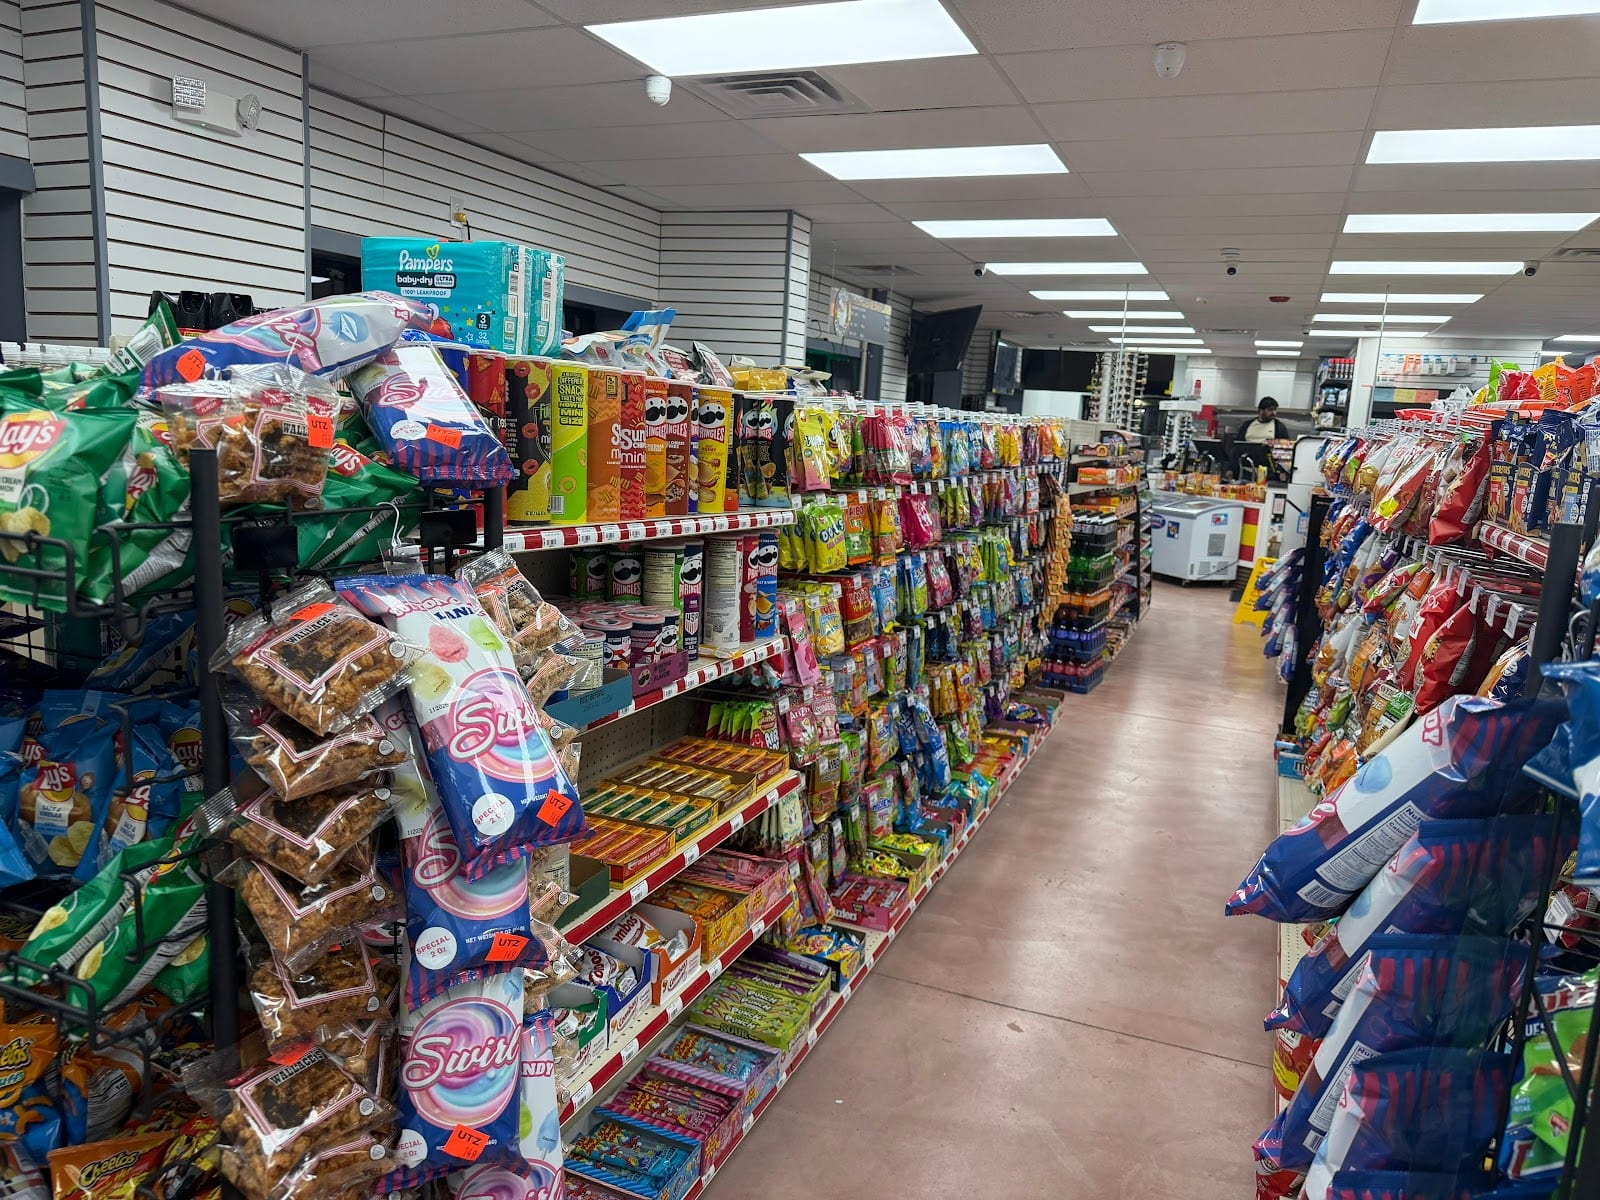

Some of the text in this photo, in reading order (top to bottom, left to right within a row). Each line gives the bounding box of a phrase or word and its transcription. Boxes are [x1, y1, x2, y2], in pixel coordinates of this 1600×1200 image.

[399, 249, 453, 273] Pampers
[480, 315, 486, 323] 3
[478, 332, 487, 340] 32
[187, 354, 202, 369] UTZ
[311, 421, 328, 430] UTZ
[560, 417, 584, 426] SIZE
[283, 422, 308, 437] WALL
[645, 425, 667, 439] RINGLE
[612, 581, 641, 596] PRINGLES
[286, 608, 341, 645] WALLACE'S
[549, 797, 566, 811] UTZ
[612, 916, 638, 943] ombos
[477, 932, 496, 942] WEIGH
[499, 938, 521, 948] UTZ
[416, 934, 450, 955] SPECIAL
[741, 997, 772, 1011] PUNCH
[747, 990, 778, 1004] PUNCH
[731, 1007, 763, 1020] PUNCH
[725, 1015, 756, 1029] PUNCH
[720, 1023, 750, 1039] SOUR
[402, 1023, 523, 1090] Swirl
[270, 1046, 325, 1085] WALLACE'S
[521, 1060, 554, 1077] NDY
[115, 1079, 128, 1090] 140
[458, 1129, 482, 1146] UTZ
[80, 1151, 140, 1188] Cheetos
